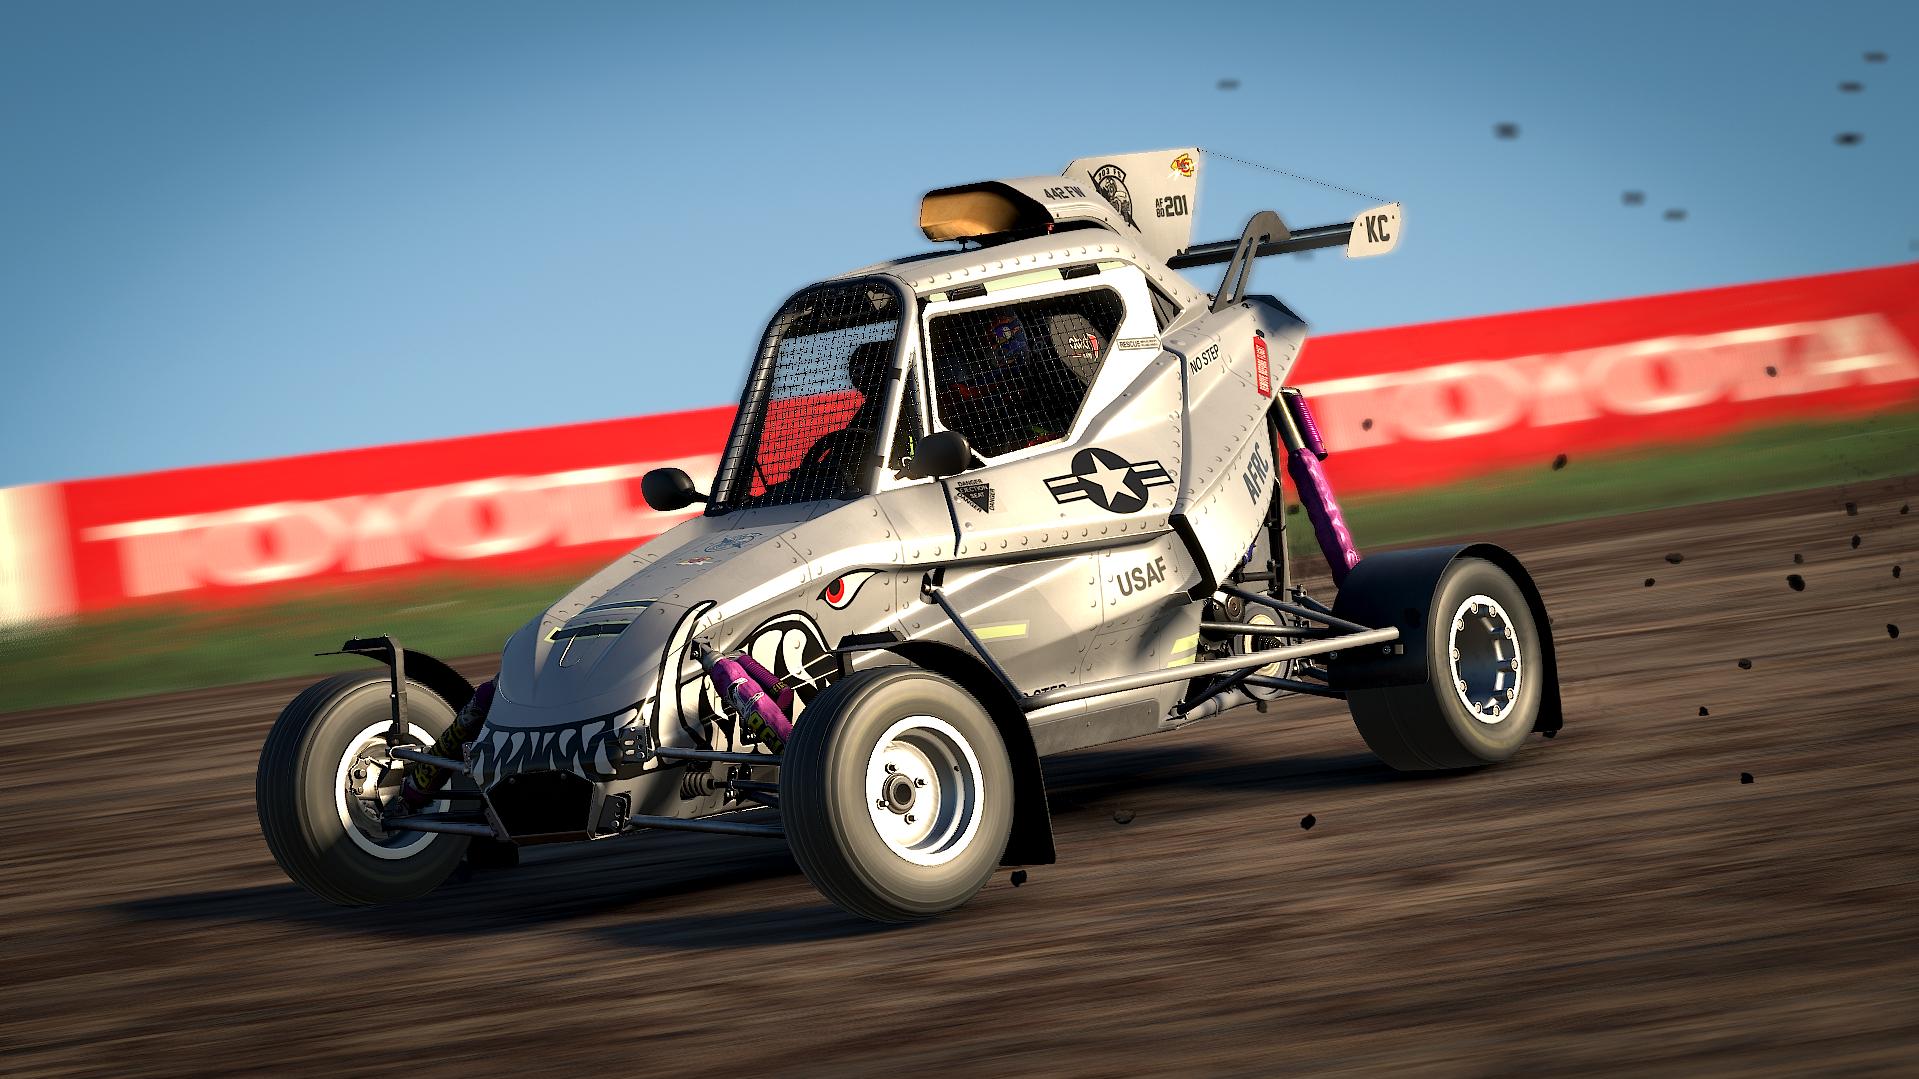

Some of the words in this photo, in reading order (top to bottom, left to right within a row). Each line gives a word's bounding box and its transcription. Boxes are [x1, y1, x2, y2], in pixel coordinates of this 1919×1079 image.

[1043, 186, 1069, 201] 442
[1066, 184, 1087, 198] FW
[1155, 197, 1164, 208] AF
[1164, 194, 1189, 218] 201
[1365, 214, 1391, 243] KC
[1118, 340, 1141, 349] RESCUE
[1189, 356, 1203, 375] NO
[1201, 343, 1219, 366] STEP
[1281, 312, 1919, 453] TOYOTA
[957, 478, 984, 487] DANGER
[1242, 441, 1269, 506] AFRC
[960, 485, 989, 493] EJECTION
[956, 492, 982, 513] DANGER
[1116, 555, 1167, 597] USAF
